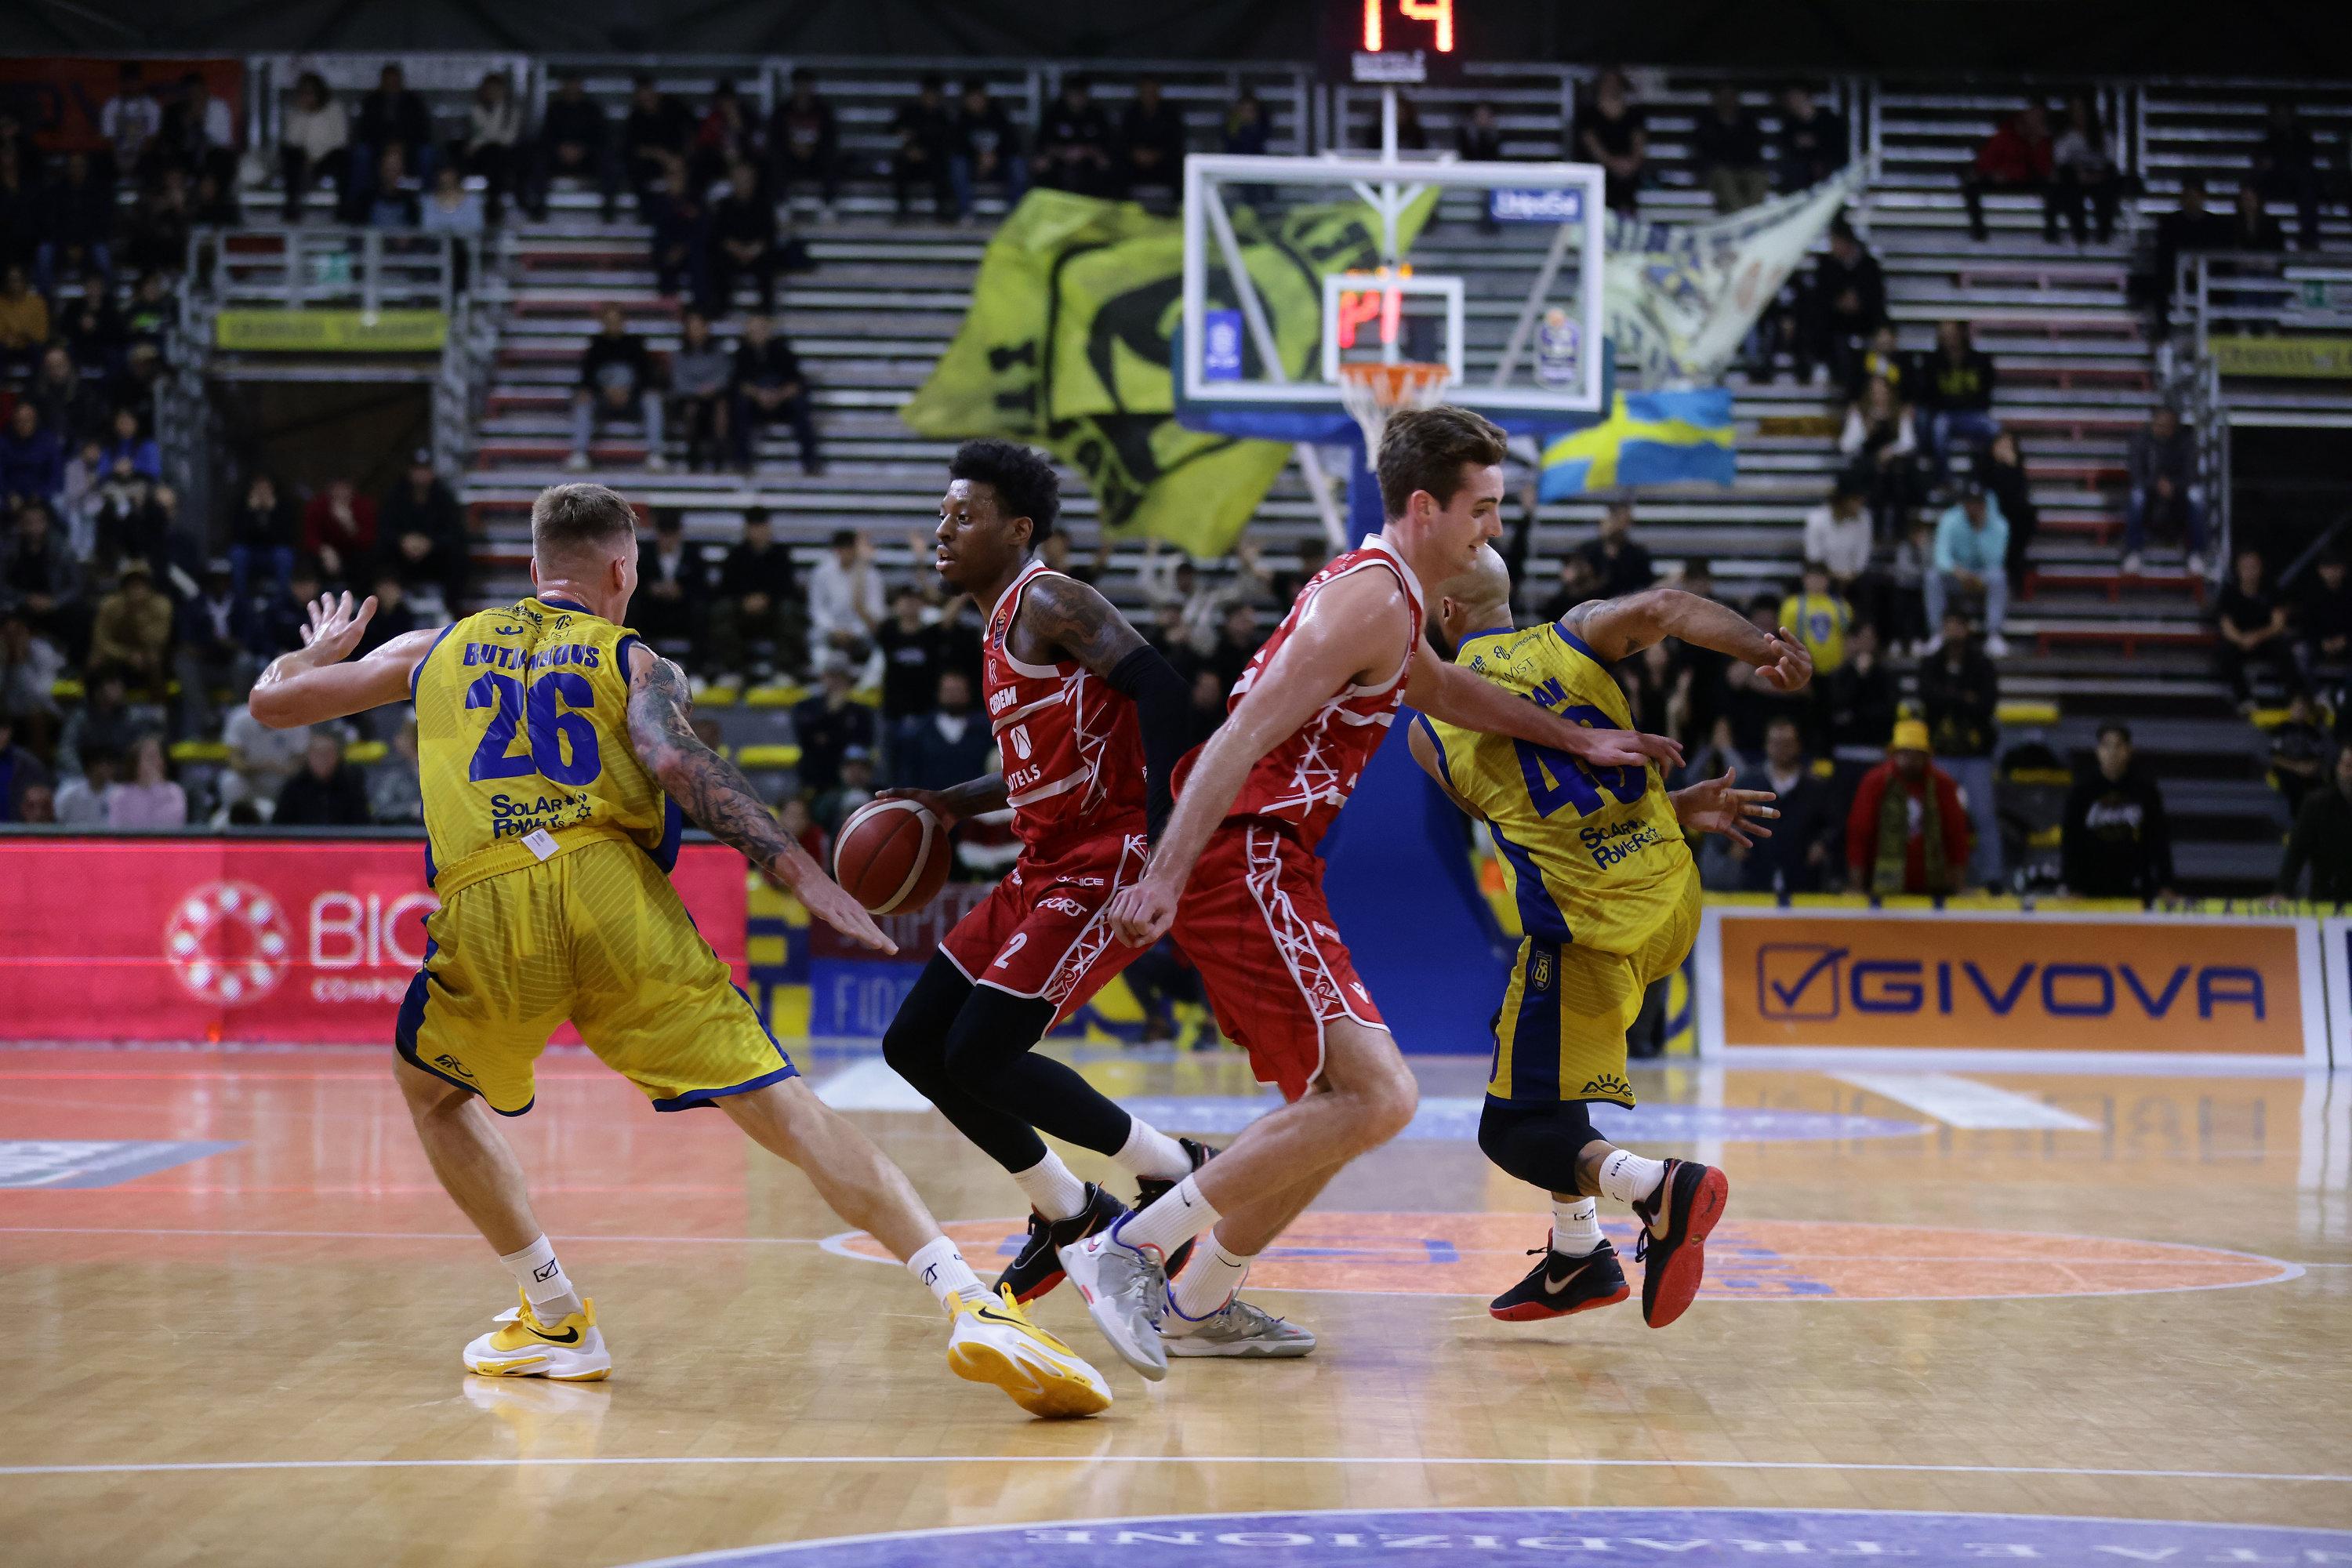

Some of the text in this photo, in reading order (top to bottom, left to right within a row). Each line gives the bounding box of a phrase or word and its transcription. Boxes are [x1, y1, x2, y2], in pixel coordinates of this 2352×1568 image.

[465, 670, 603, 786] 26
[1006, 764, 1041, 793] OTELS
[993, 932, 1028, 970] 2
[1849, 960, 2267, 1021] GIVOVA
